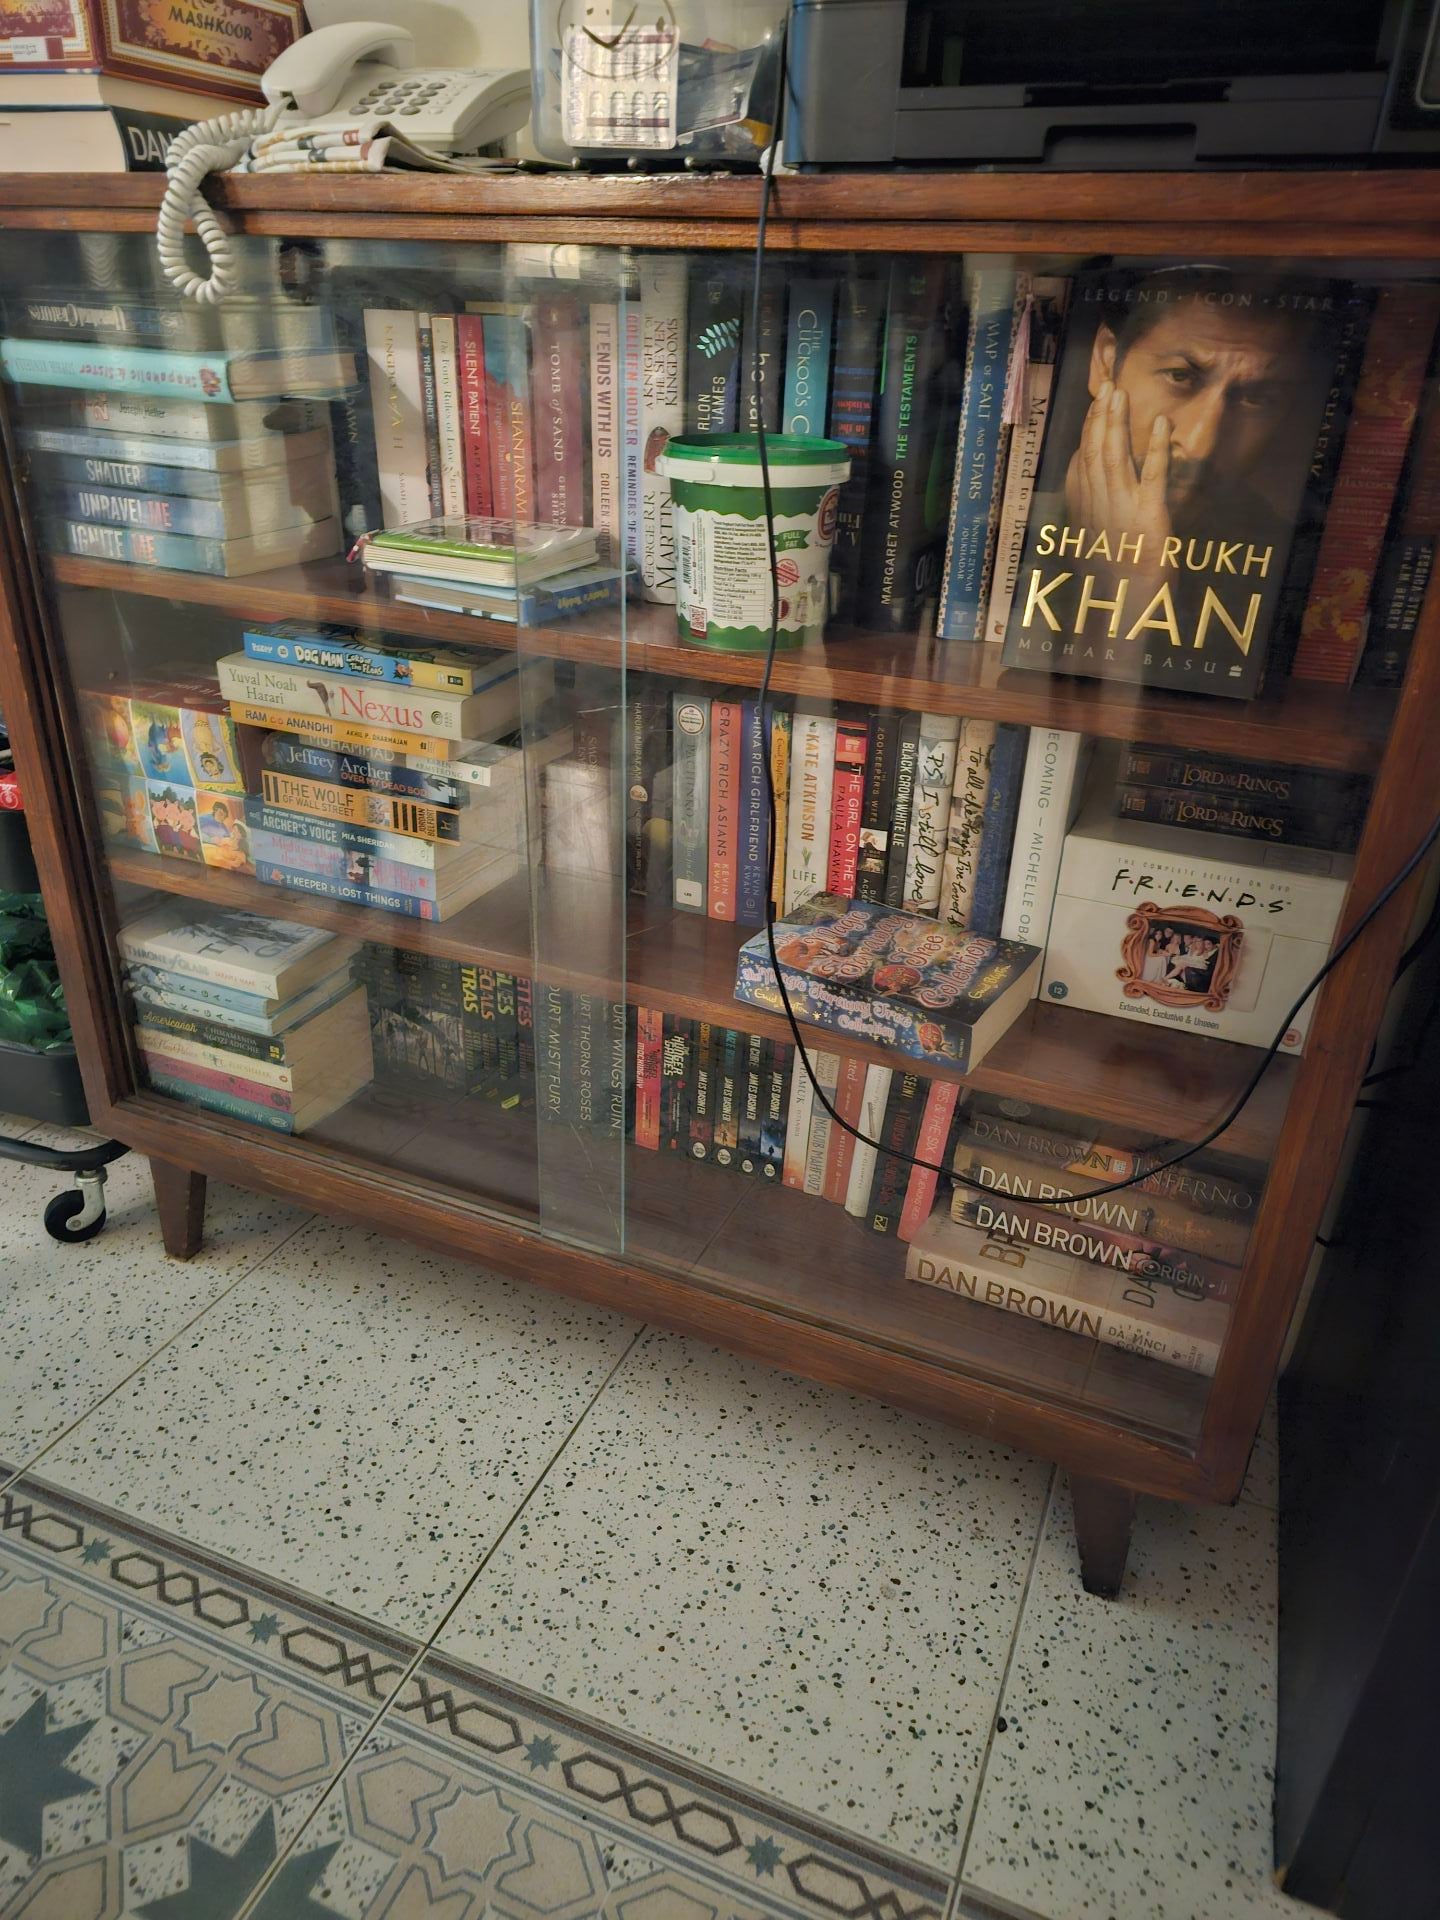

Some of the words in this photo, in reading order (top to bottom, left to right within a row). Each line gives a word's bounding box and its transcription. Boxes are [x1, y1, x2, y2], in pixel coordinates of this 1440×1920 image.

[168, 7, 252, 41] MASHKOOR
[1083, 289, 1167, 303] LEGEND
[1192, 292, 1252, 308] ICON
[1277, 297, 1334, 311] STAR
[597, 322, 611, 339] IT
[654, 320, 666, 373] SEVEN
[986, 320, 1000, 359] MAP
[423, 354, 431, 371] THE
[625, 313, 638, 381] COLLEEN
[665, 318, 679, 407] KINGDOMS
[464, 341, 478, 386] SILENT
[550, 344, 562, 394] TOMB
[597, 344, 611, 386] ENDS
[984, 364, 992, 374] OF
[425, 373, 435, 419] PROPHET
[654, 375, 666, 403] THE
[900, 335, 918, 429] TESTAMENTS
[468, 390, 480, 437] PATIENT
[551, 399, 561, 415] of
[597, 390, 612, 432] WITH
[625, 387, 638, 445] HOOVER
[712, 375, 726, 425] JAMES
[978, 381, 994, 422] SALT
[552, 417, 564, 462] SAND
[598, 437, 612, 458] US
[895, 434, 907, 460] THE
[977, 427, 986, 446] AND
[1021, 397, 1046, 481] Married
[86, 459, 141, 486] SHATTER
[511, 401, 527, 515] SHANTARAM
[968, 452, 986, 500] STARS
[1018, 486, 1028, 500] to
[71, 524, 123, 557] IGNITE
[655, 490, 674, 589] MARTIN
[782, 531, 801, 541] FULL
[881, 529, 898, 605] MARGARET
[891, 469, 905, 522] ATWOOD
[1037, 524, 1145, 565] SHAH
[1160, 537, 1274, 578] RUKH
[643, 525, 656, 589] GEORGE
[1004, 519, 1025, 595] Bedouin
[1021, 569, 1262, 656] KHAN
[294, 645, 318, 666] DOG
[320, 650, 345, 668] MAN
[1018, 639, 1116, 662] MOHAR
[1144, 653, 1216, 674] BASU
[229, 668, 260, 686] Yuval
[264, 675, 297, 692] Noah
[247, 687, 285, 704] Harari
[245, 709, 268, 723] RAM
[286, 717, 334, 735] ANANDHI
[340, 686, 424, 729] Nexus
[634, 702, 642, 732] HARUKI
[718, 705, 731, 754] CRAZY
[750, 705, 763, 749] CHINA
[286, 745, 336, 773] Jeffrey
[340, 758, 392, 781] Archer
[633, 733, 642, 781] MURAKAMI
[803, 733, 820, 769] KATE
[904, 742, 915, 773] BLACK
[340, 772, 365, 785] OVER
[367, 777, 382, 787] MY
[383, 781, 406, 793] DEAD
[717, 762, 729, 798] RICH
[750, 752, 763, 785] RICH
[853, 765, 862, 792] THE
[1038, 732, 1060, 809] ECOMING
[1181, 764, 1224, 788] LORD
[281, 780, 310, 799] THE
[312, 787, 354, 807] WOLF
[902, 774, 912, 802] CROW
[923, 789, 940, 806] I
[1236, 773, 1291, 799] RINGS
[283, 794, 296, 804] OF
[297, 797, 320, 811] WALL
[321, 802, 355, 817] STREET
[418, 808, 427, 833] JORDAN
[800, 773, 818, 842] ATKINSON
[848, 800, 860, 829] GIRL
[896, 802, 909, 834] WHITE
[1175, 801, 1218, 824] LORD
[263, 815, 307, 837] ARCHER'S
[309, 824, 338, 843] VOICE
[428, 808, 436, 838] BELFORT
[716, 805, 729, 857] ASIANS
[749, 788, 762, 861] GIRLFRIEND
[917, 807, 939, 858] still
[1230, 810, 1285, 837] RINGS
[341, 832, 356, 842] MIA
[357, 834, 396, 849] SHERIDAN
[847, 832, 857, 852] ON
[893, 834, 904, 848] LIE
[713, 863, 721, 892] KWAN
[721, 863, 729, 895] KEVIN
[743, 864, 751, 894] KWAN
[752, 866, 761, 896] KEVIN
[792, 869, 817, 884] LIFE
[844, 857, 856, 885] THE
[911, 855, 938, 902] love
[1021, 832, 1043, 906] MICHELLE
[293, 876, 328, 893] KEEPER
[338, 883, 362, 899] LOST
[365, 891, 401, 908] THINGS
[804, 910, 870, 953] Magic
[889, 934, 943, 967] Tree
[920, 937, 997, 1008] Collection
[143, 1010, 197, 1032] Americanah
[837, 1012, 897, 1041] Collection
[1152, 1008, 1184, 1023] Exclusive
[1184, 1015, 1192, 1025] &
[1193, 1016, 1220, 1030] Unseen
[548, 1032, 561, 1068] MIST
[579, 1024, 592, 1077] THORNS
[611, 1038, 624, 1089] WINGS
[663, 1039, 674, 1076] GAMES
[671, 1036, 685, 1075] HUNGER
[548, 1075, 561, 1114] FURY
[696, 1070, 708, 1090] JAMES
[722, 1076, 733, 1096] JAMES
[747, 1072, 758, 1093] JAMES
[771, 1072, 783, 1093] JAMES
[579, 1080, 592, 1121] ROSES
[610, 1094, 623, 1129] RUIN
[696, 1091, 707, 1114] DASHNER
[722, 1097, 733, 1121] DASHNER
[746, 1093, 757, 1121] DASHNER
[769, 1093, 782, 1121] DASHNER
[934, 1104, 945, 1114] &
[812, 1118, 828, 1149] NAGUIB
[930, 1114, 944, 1135] THE
[925, 1135, 940, 1153] SIX
[973, 1119, 1022, 1147] DAN
[1027, 1136, 1112, 1172] BROWN
[807, 1150, 823, 1192] MAHFOUZ
[1135, 1156, 1253, 1209] INFERNO
[977, 1165, 1032, 1198] DAN
[1038, 1183, 1138, 1232] BROWN
[976, 1204, 1030, 1239] DAN
[1033, 1222, 1132, 1271] BROWN
[1140, 1259, 1206, 1288] ORIGIN
[917, 1258, 977, 1297] DAN
[984, 1280, 1103, 1340] BROWN
[1108, 1326, 1125, 1339] DA
[1133, 1332, 1167, 1353] VINCI
